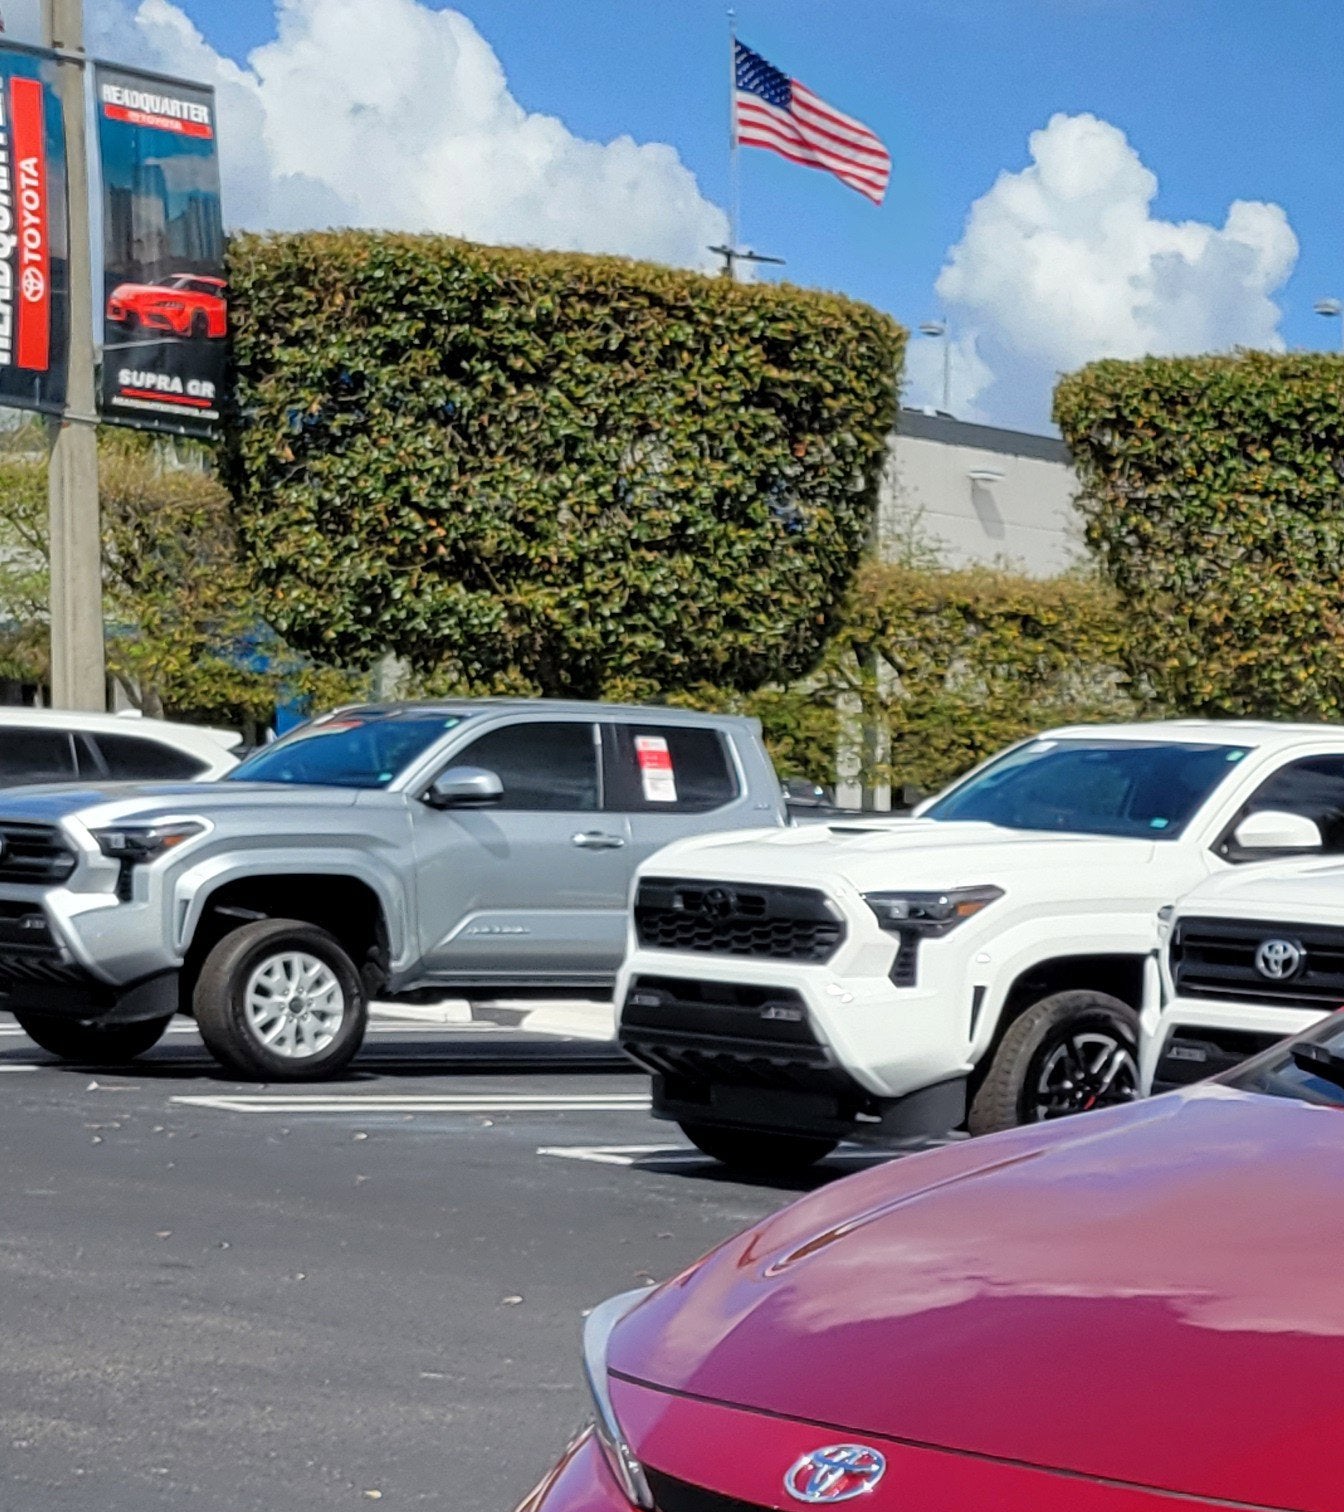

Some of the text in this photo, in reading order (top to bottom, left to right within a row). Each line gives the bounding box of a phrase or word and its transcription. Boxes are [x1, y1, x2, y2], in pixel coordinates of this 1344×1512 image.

[102, 83, 209, 123] HEADQUARTER
[20, 157, 42, 265] TOYOTA
[118, 368, 215, 399] SUPRA GR
